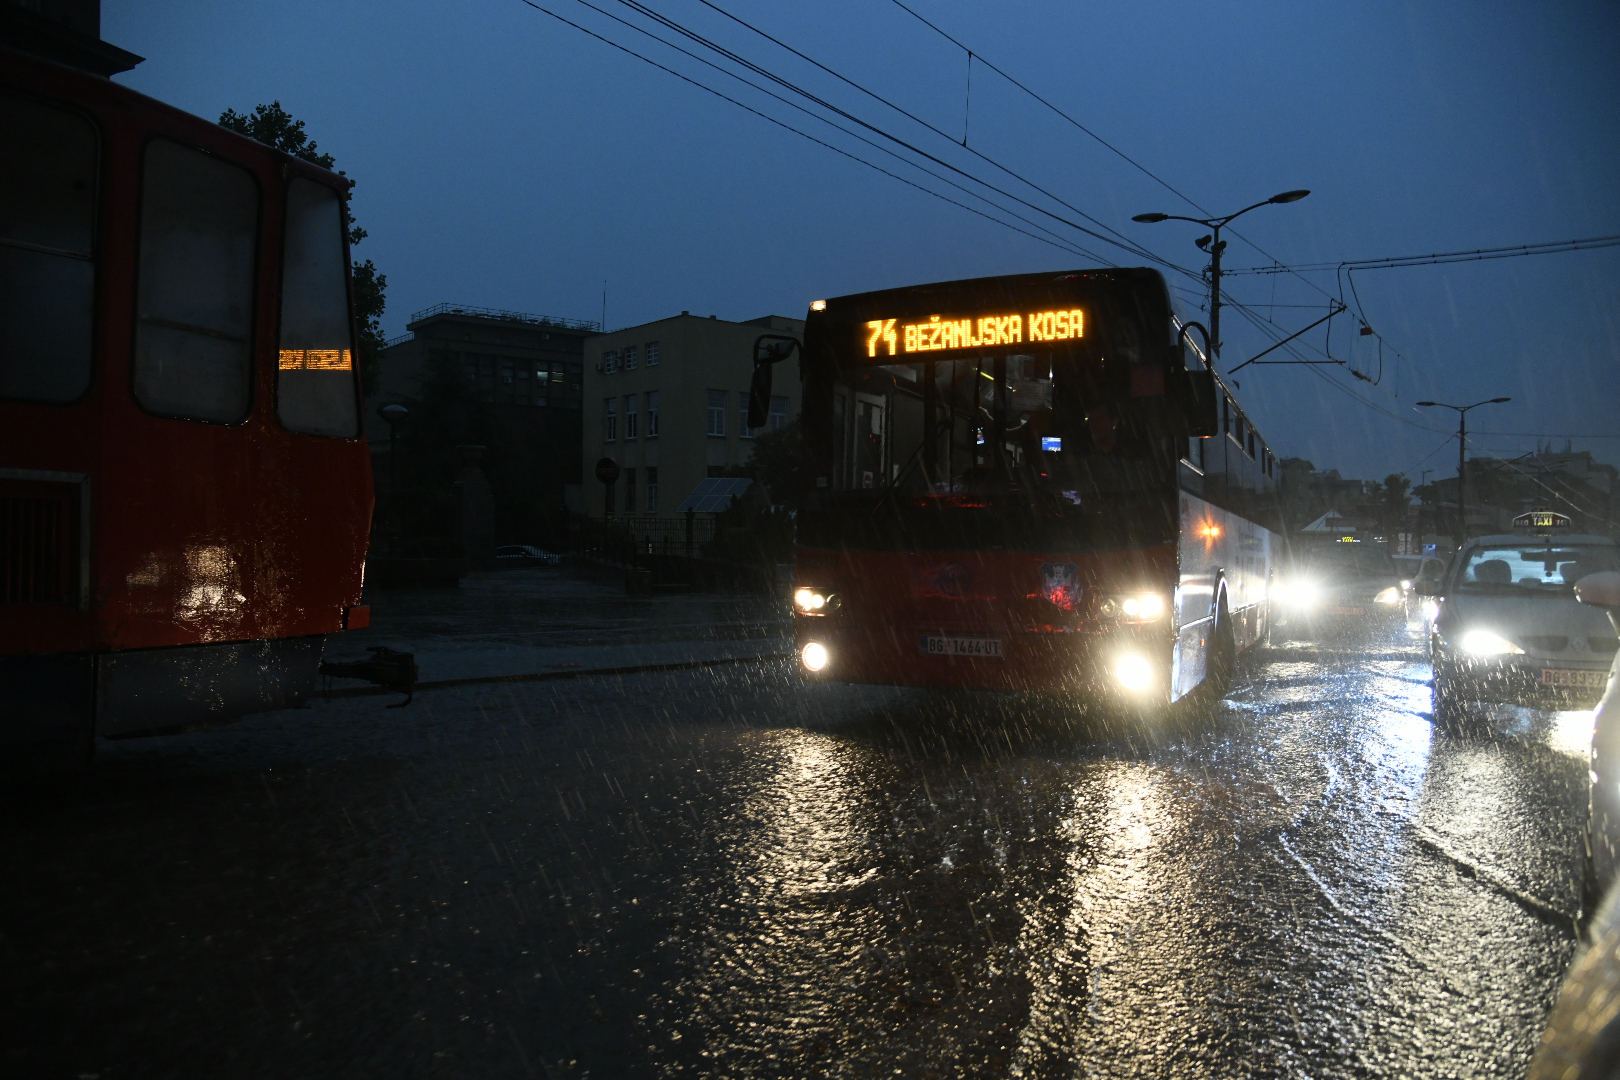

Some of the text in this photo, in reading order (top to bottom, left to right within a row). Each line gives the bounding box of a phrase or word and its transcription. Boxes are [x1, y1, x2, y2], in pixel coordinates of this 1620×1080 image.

[867, 310, 1084, 358] 74 BEŽANIJSKA KOSA
[1532, 517, 1552, 526] TAXI
[929, 639, 943, 652] BG
[1545, 671, 1559, 683] BG
